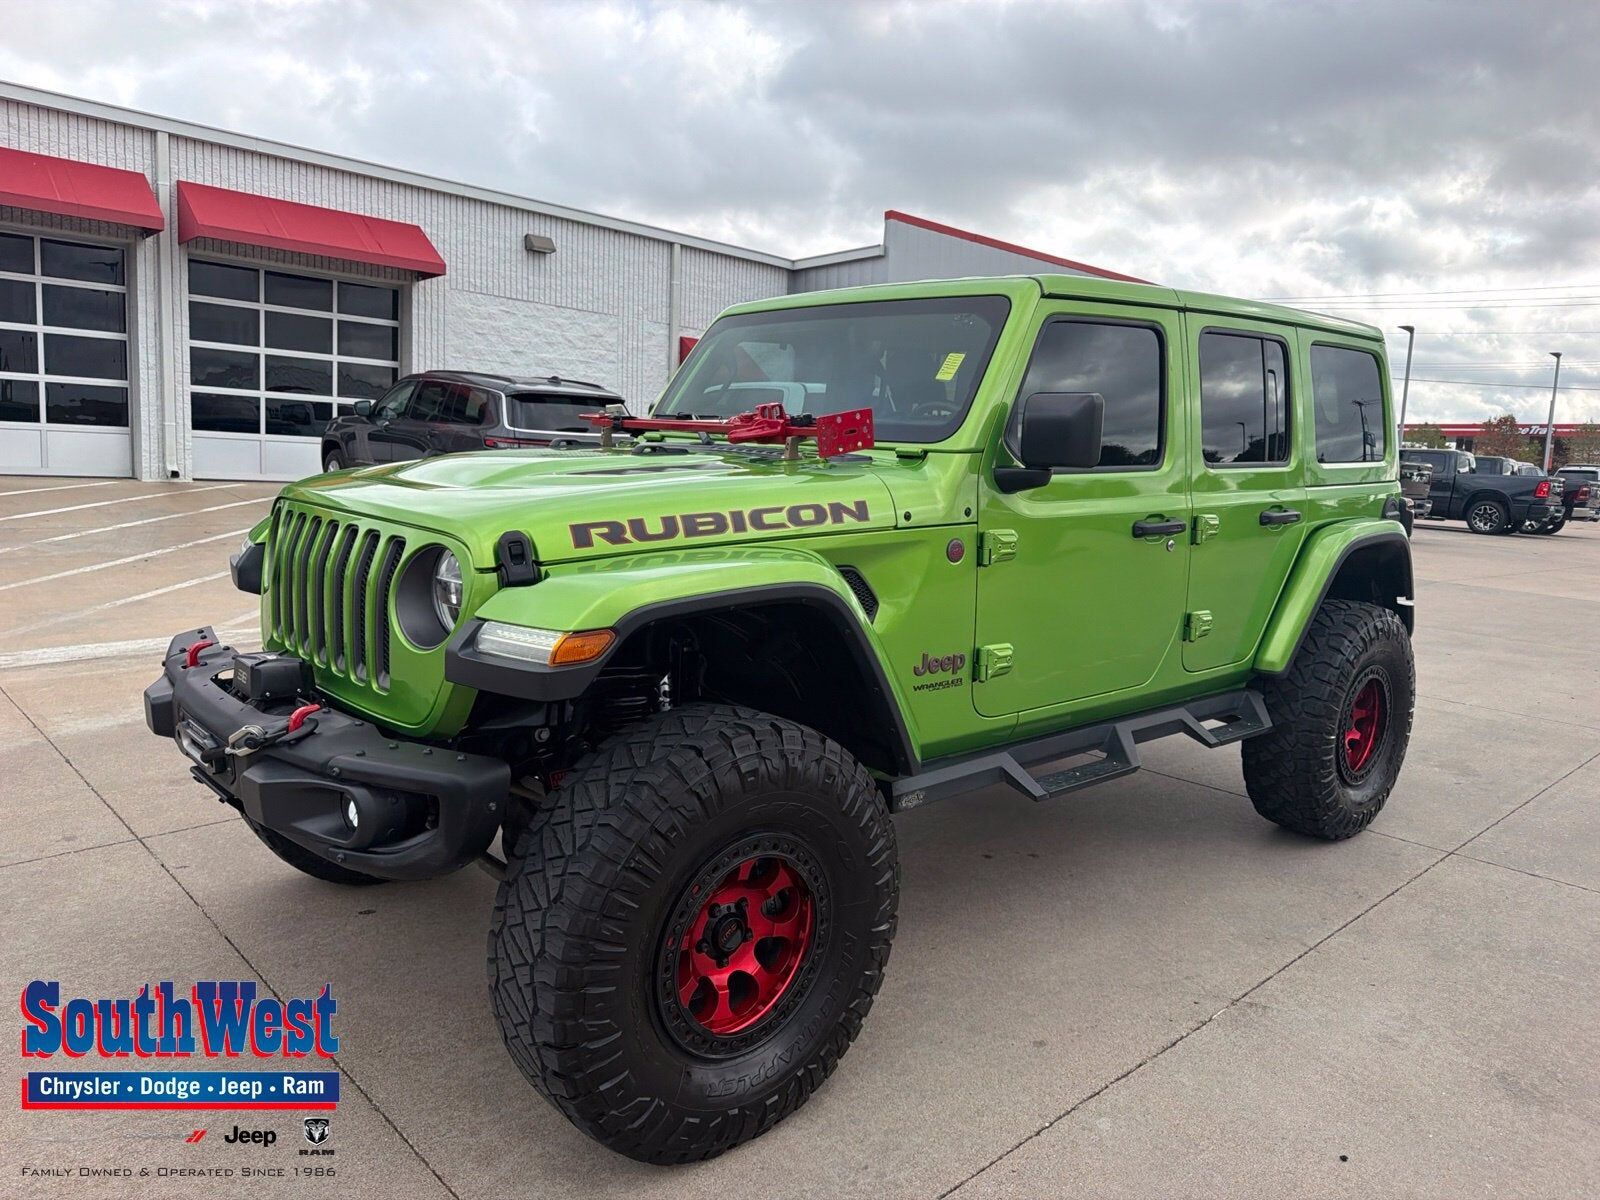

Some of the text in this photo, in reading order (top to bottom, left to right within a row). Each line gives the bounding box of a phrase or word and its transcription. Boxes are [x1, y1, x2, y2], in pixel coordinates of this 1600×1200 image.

[568, 500, 870, 550] RUBICON
[913, 652, 966, 677] Jeep
[912, 677, 963, 692] WRANGLER
